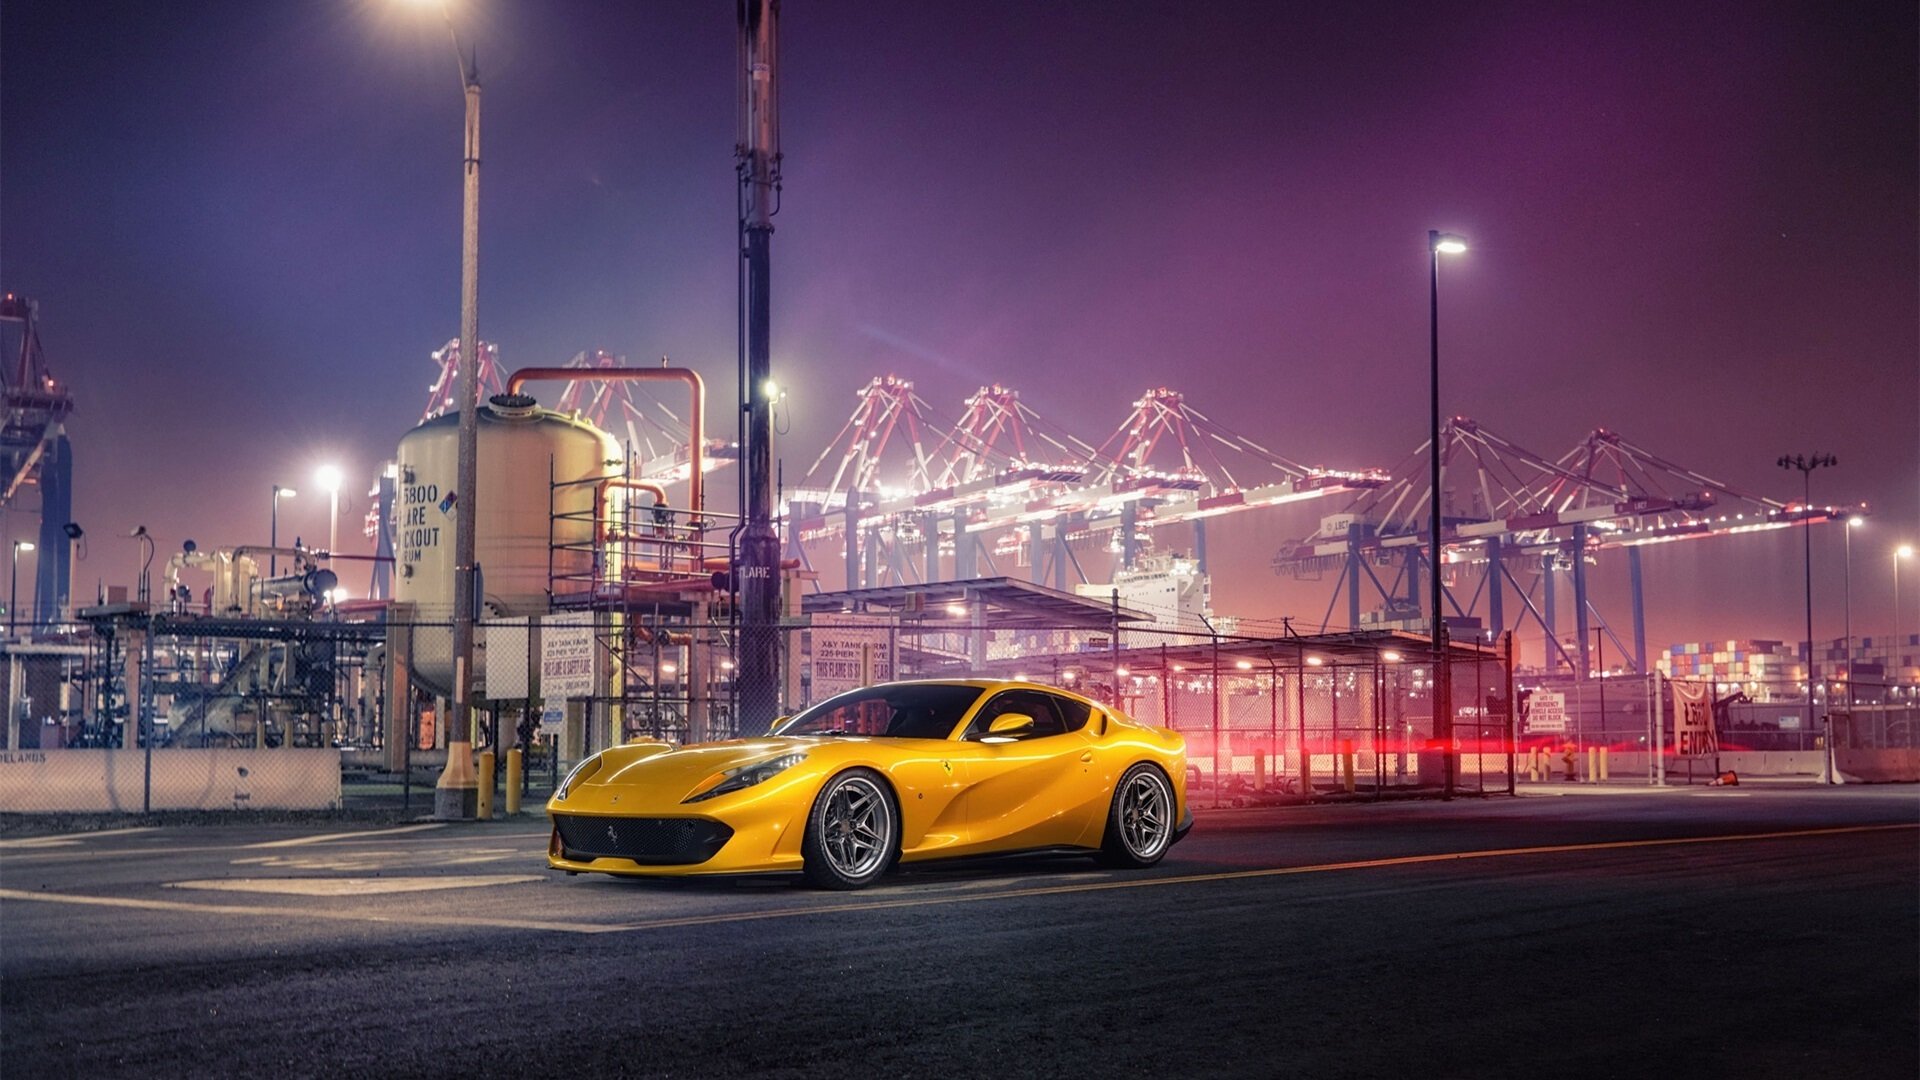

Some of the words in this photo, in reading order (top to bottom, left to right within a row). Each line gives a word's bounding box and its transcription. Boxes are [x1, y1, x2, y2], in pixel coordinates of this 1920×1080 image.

[822, 640, 838, 649] X&Y
[841, 641, 861, 650] TANK
[863, 642, 887, 651] FRM
[820, 650, 834, 658] 225
[836, 650, 854, 658] PIER
[816, 661, 828, 678] THIS
[829, 662, 847, 679] FLAME
[847, 662, 854, 679] IS
[874, 663, 889, 680] FLAR
[1680, 729, 1719, 755] ENTRY
